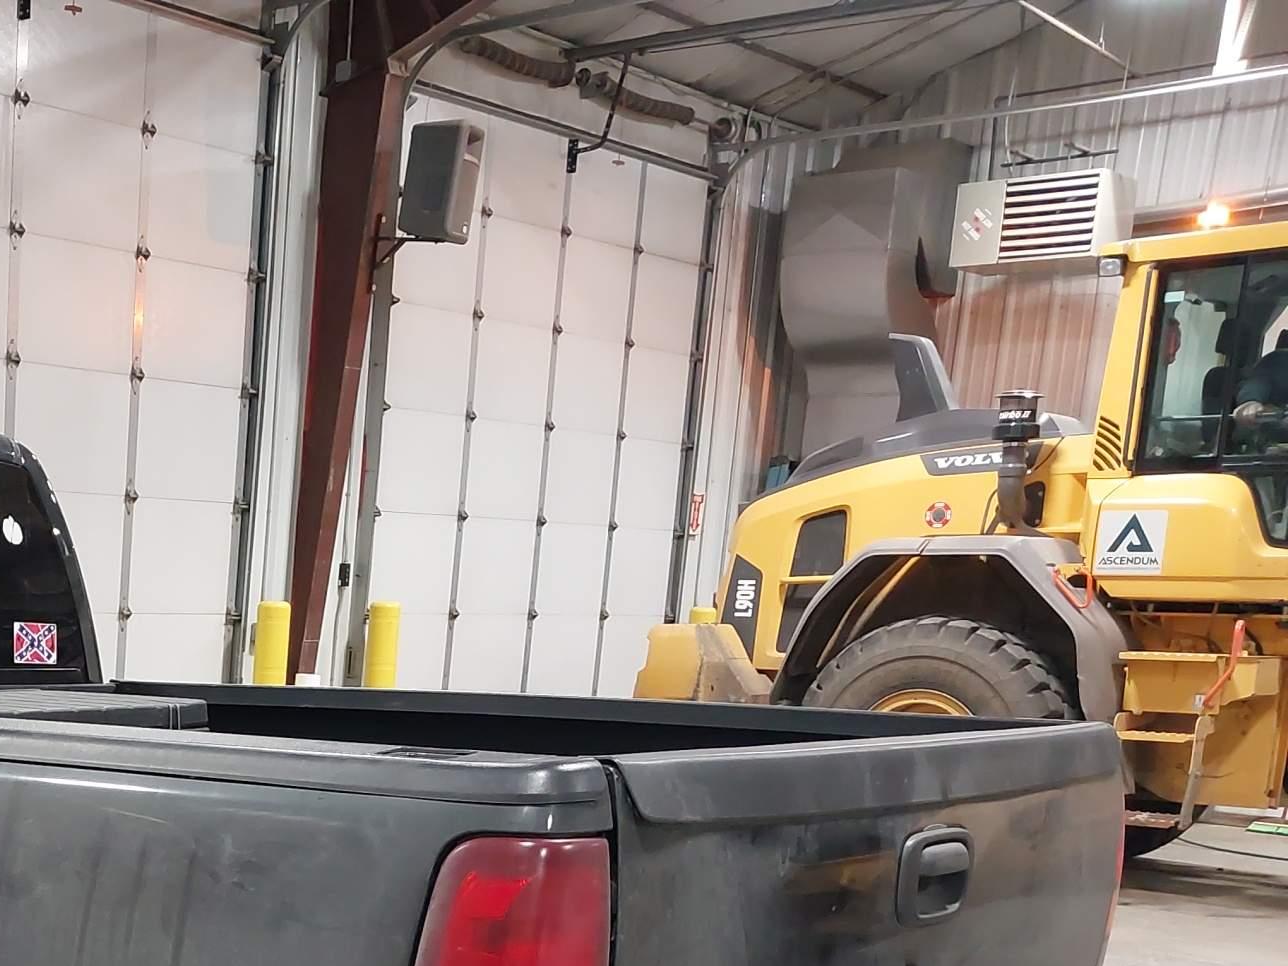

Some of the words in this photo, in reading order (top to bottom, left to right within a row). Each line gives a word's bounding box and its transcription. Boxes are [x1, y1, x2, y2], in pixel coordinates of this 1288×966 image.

[934, 452, 1003, 469] VOLV
[1098, 556, 1159, 566] ASCENDUM
[734, 579, 757, 618] L90H
